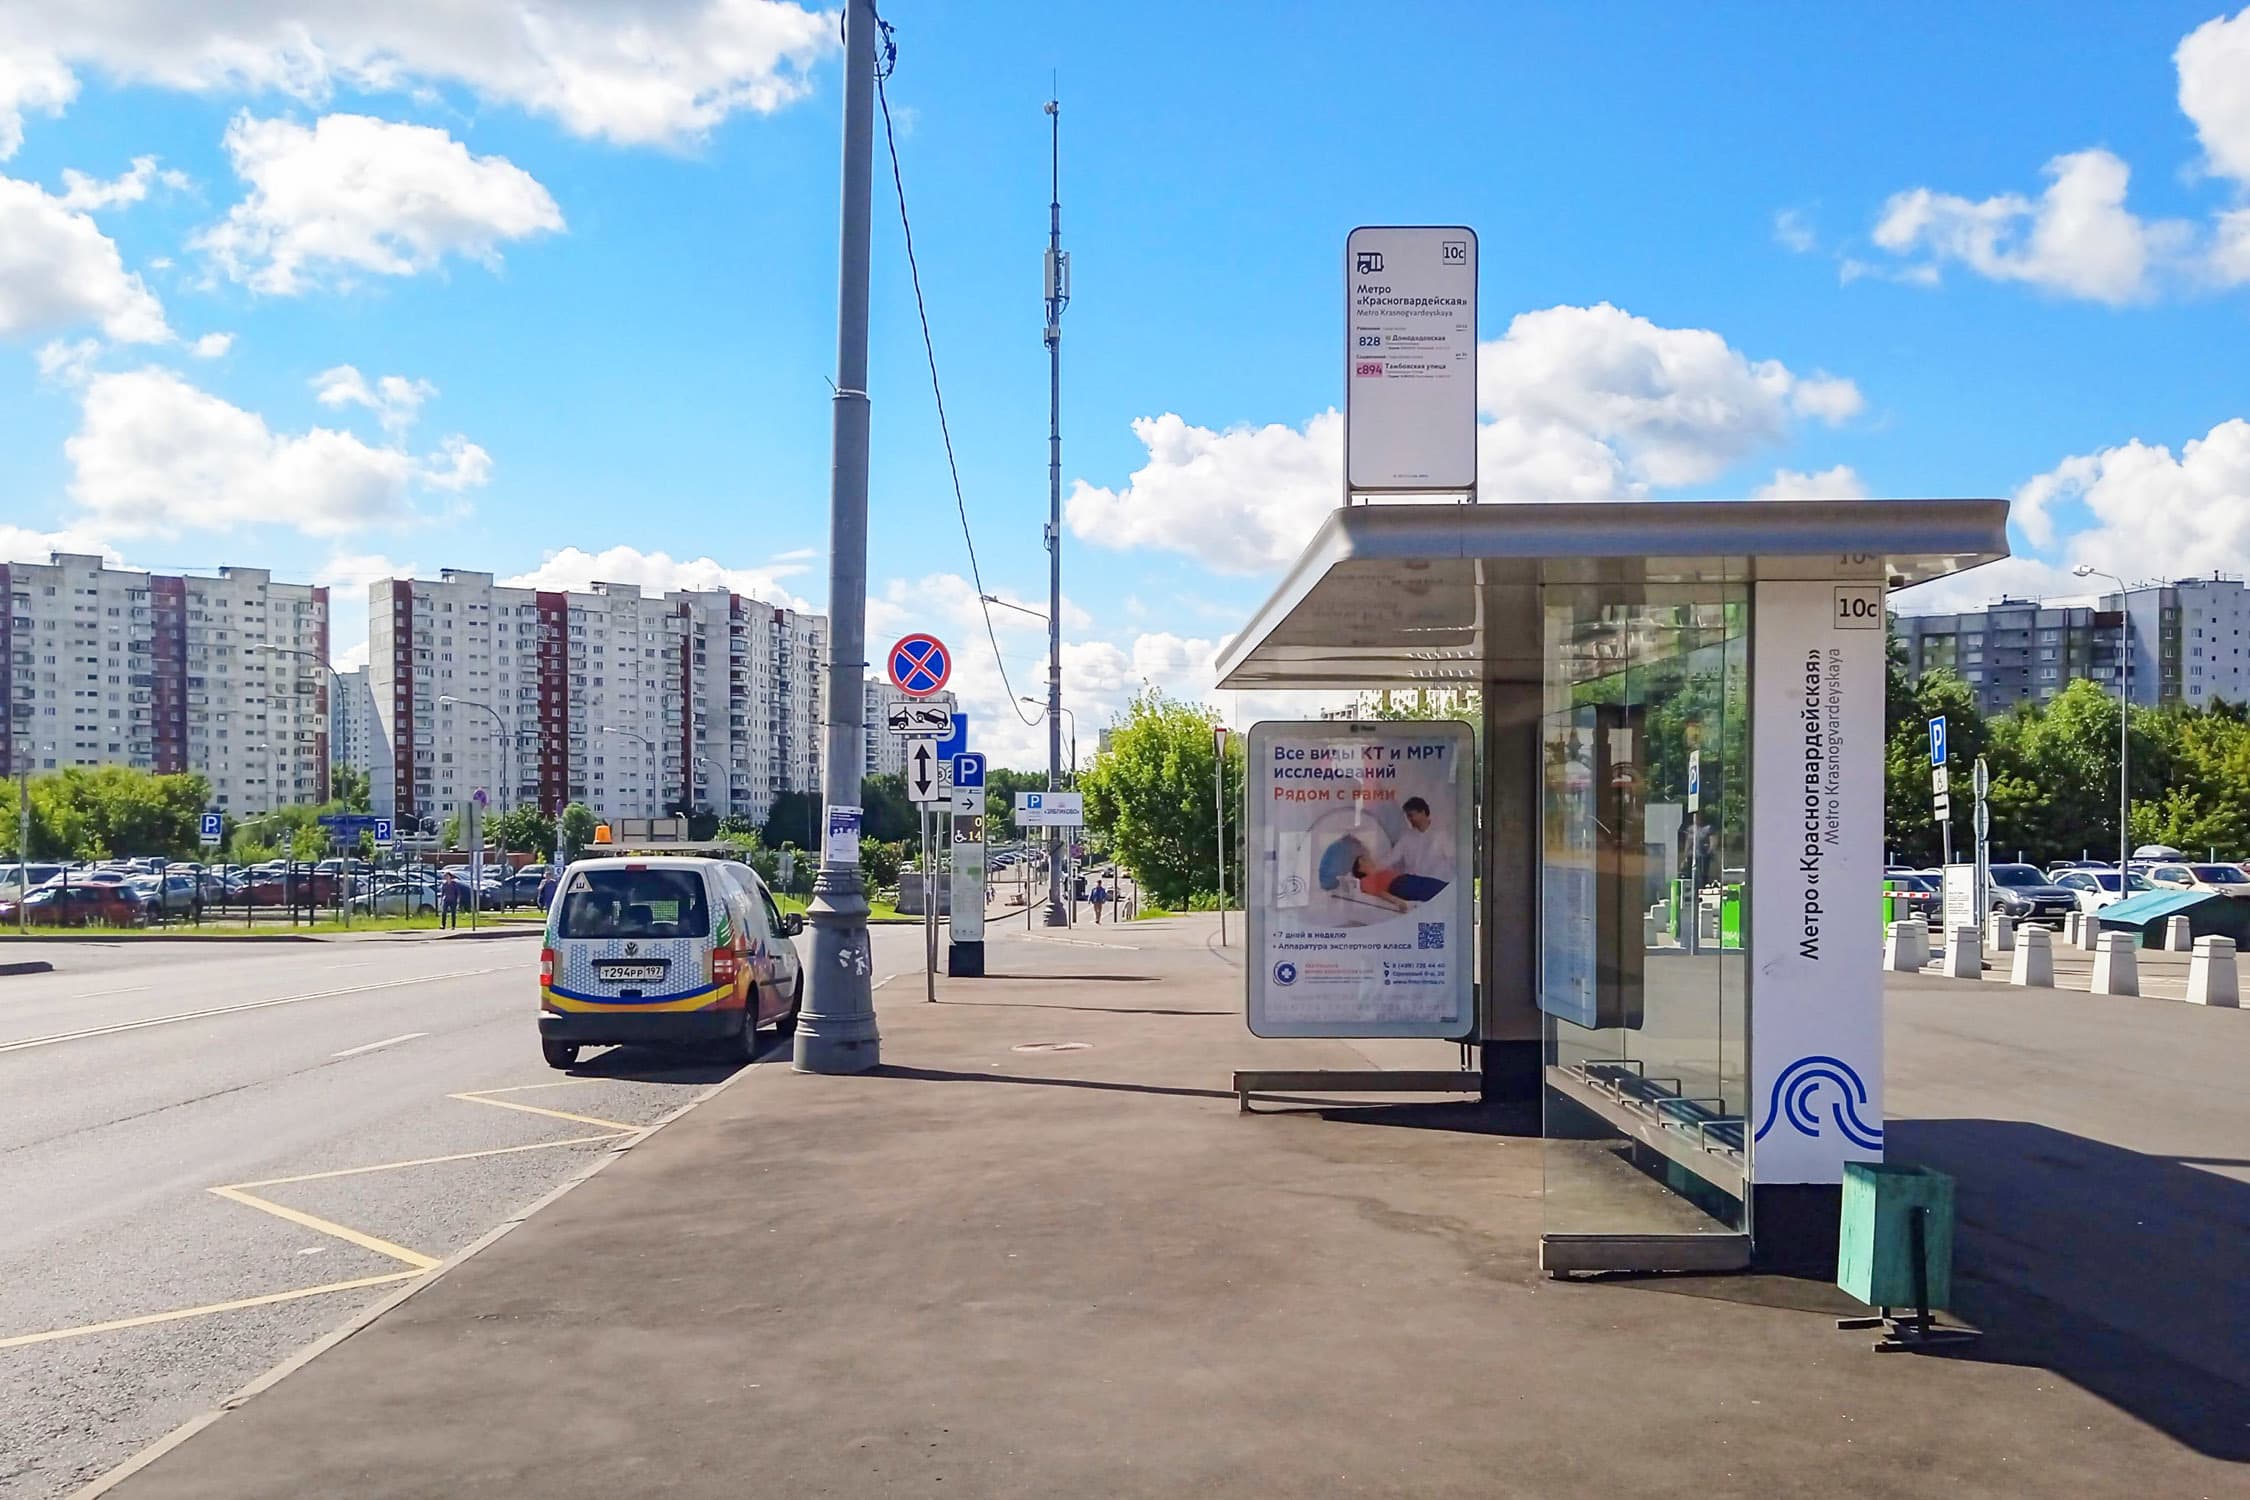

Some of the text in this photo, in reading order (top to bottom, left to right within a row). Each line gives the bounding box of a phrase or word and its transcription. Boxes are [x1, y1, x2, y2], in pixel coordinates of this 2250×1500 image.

[1357, 284, 1392, 295] Метро
[1357, 296, 1467, 307] «Красногвардейская»
[1357, 309, 1379, 317] Metro
[1359, 336, 1381, 347] 828
[1356, 364, 1383, 375] с894
[1840, 598, 1877, 617] 10с
[1274, 746, 1305, 760] Все
[1361, 746, 1384, 760] КТ
[1390, 749, 1400, 760] и
[1407, 746, 1445, 760] МРТ
[1824, 648, 1843, 845] Metro Krasnogvardeyskaya
[961, 758, 978, 783] P
[1274, 764, 1396, 780] исследований
[1274, 787, 1396, 802] Рядом с вами
[1800, 649, 1824, 960] Метро «Красногвардейская»
[205, 816, 218, 833] P
[975, 817, 982, 827] 0
[377, 822, 388, 838] P
[969, 831, 982, 841] 14
[1278, 943, 1328, 951] Аппаратура
[1329, 943, 1381, 951] экспертного
